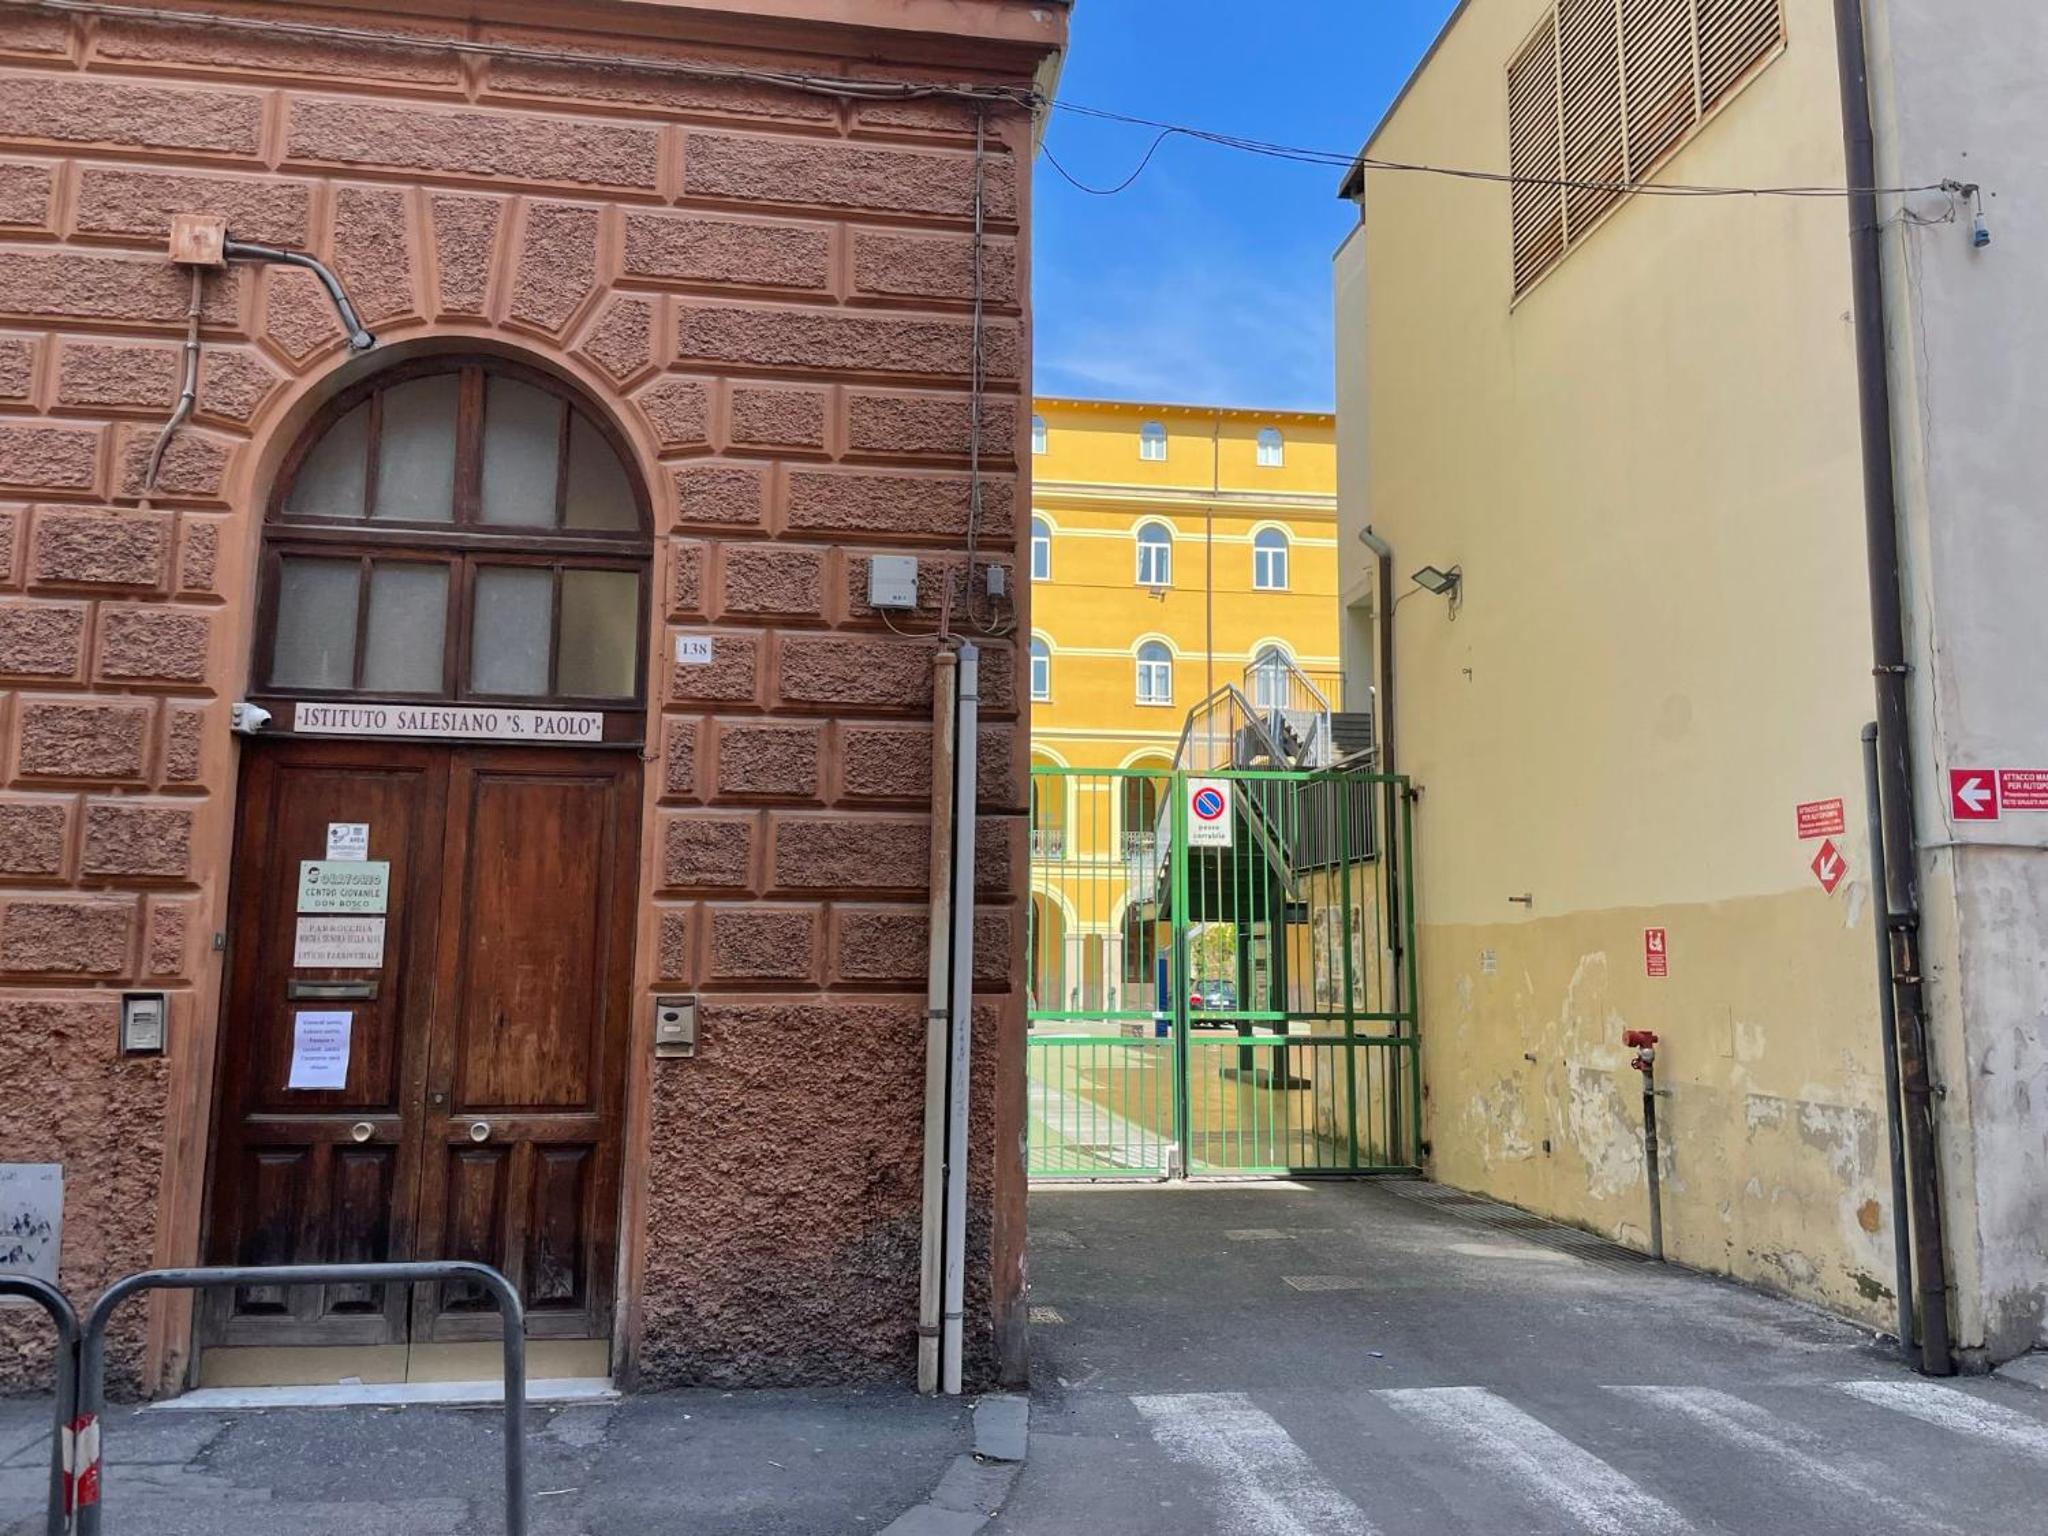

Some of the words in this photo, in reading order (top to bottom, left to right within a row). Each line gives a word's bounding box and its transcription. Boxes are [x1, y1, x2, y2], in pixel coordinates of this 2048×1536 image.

[683, 643, 707, 655] 138
[303, 707, 387, 729] ISTITUTO
[397, 711, 498, 733] SALESIANO
[305, 886, 337, 897] CENTRO
[340, 887, 381, 898] GIOVANILE
